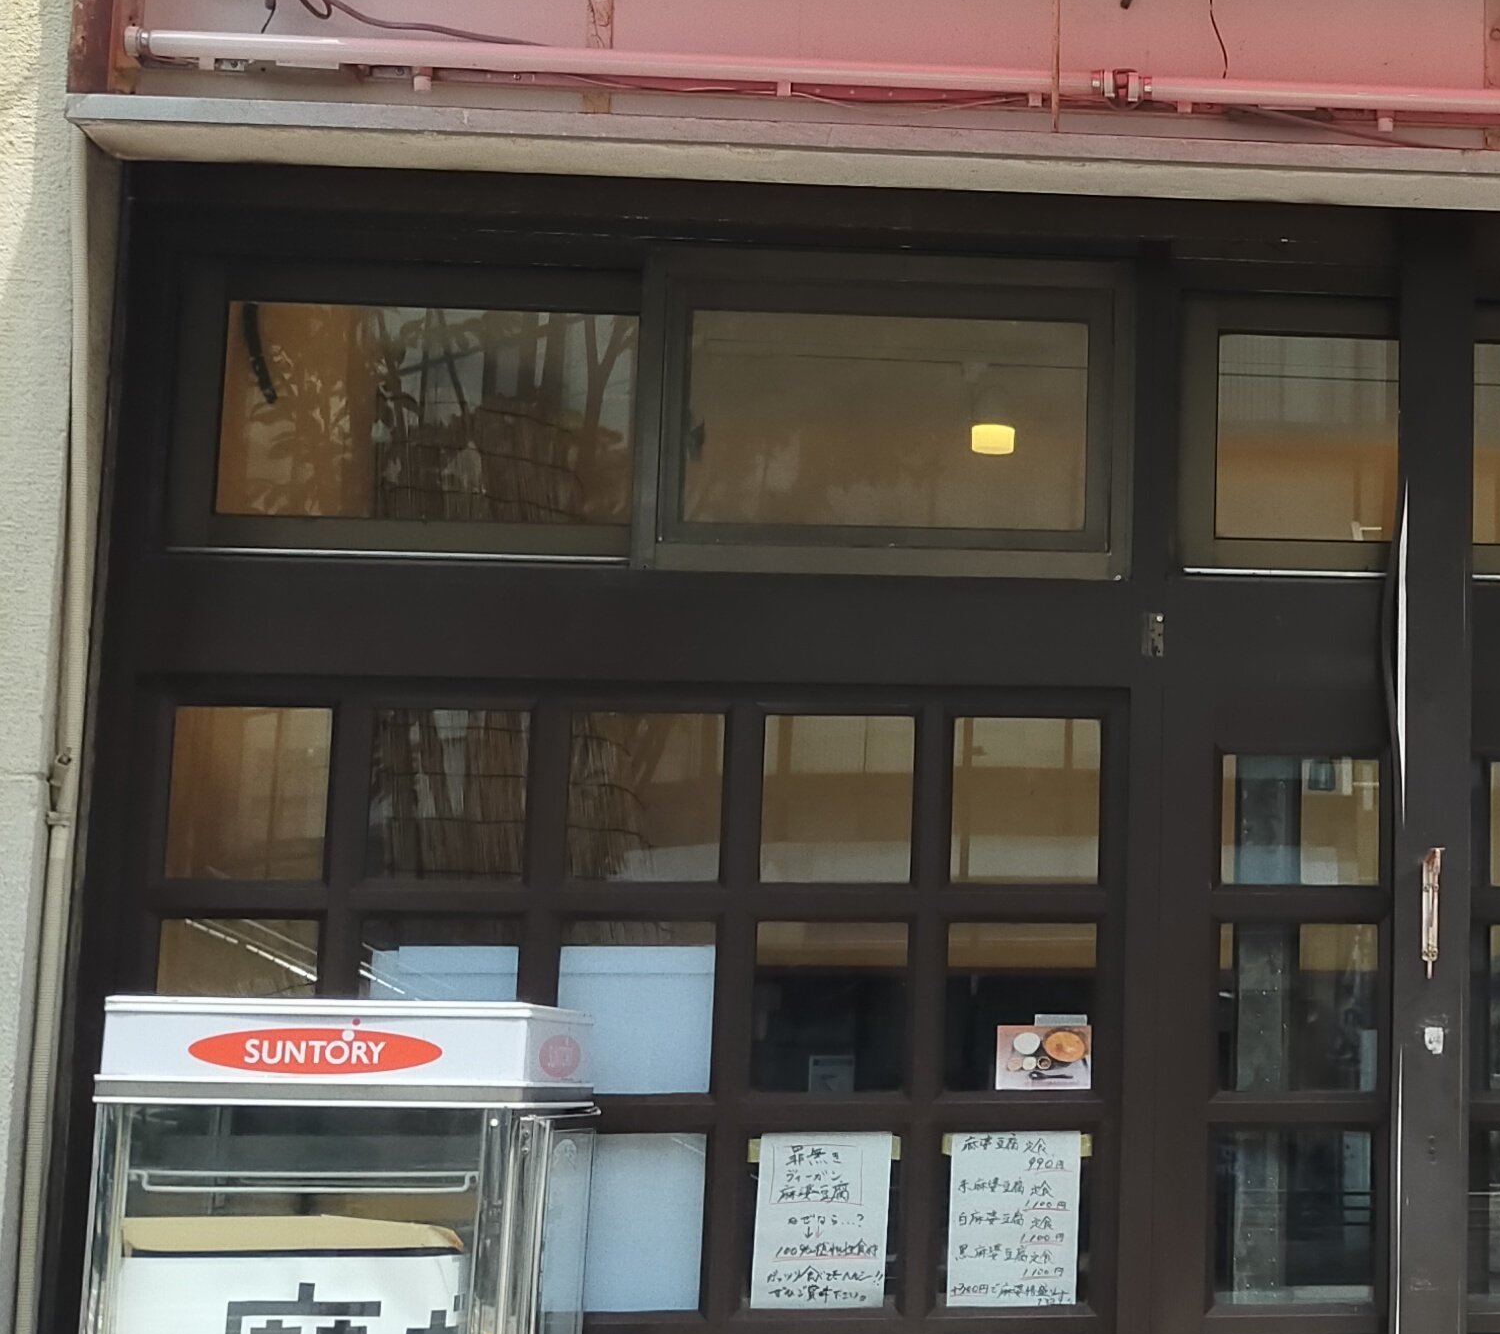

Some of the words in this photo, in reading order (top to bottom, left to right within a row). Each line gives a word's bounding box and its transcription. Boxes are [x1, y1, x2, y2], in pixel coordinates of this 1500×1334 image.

[244, 1038, 386, 1065] SUNTORY
[1027, 1157, 1064, 1171] 990円
[777, 1181, 849, 1203] 麻婆豆腐
